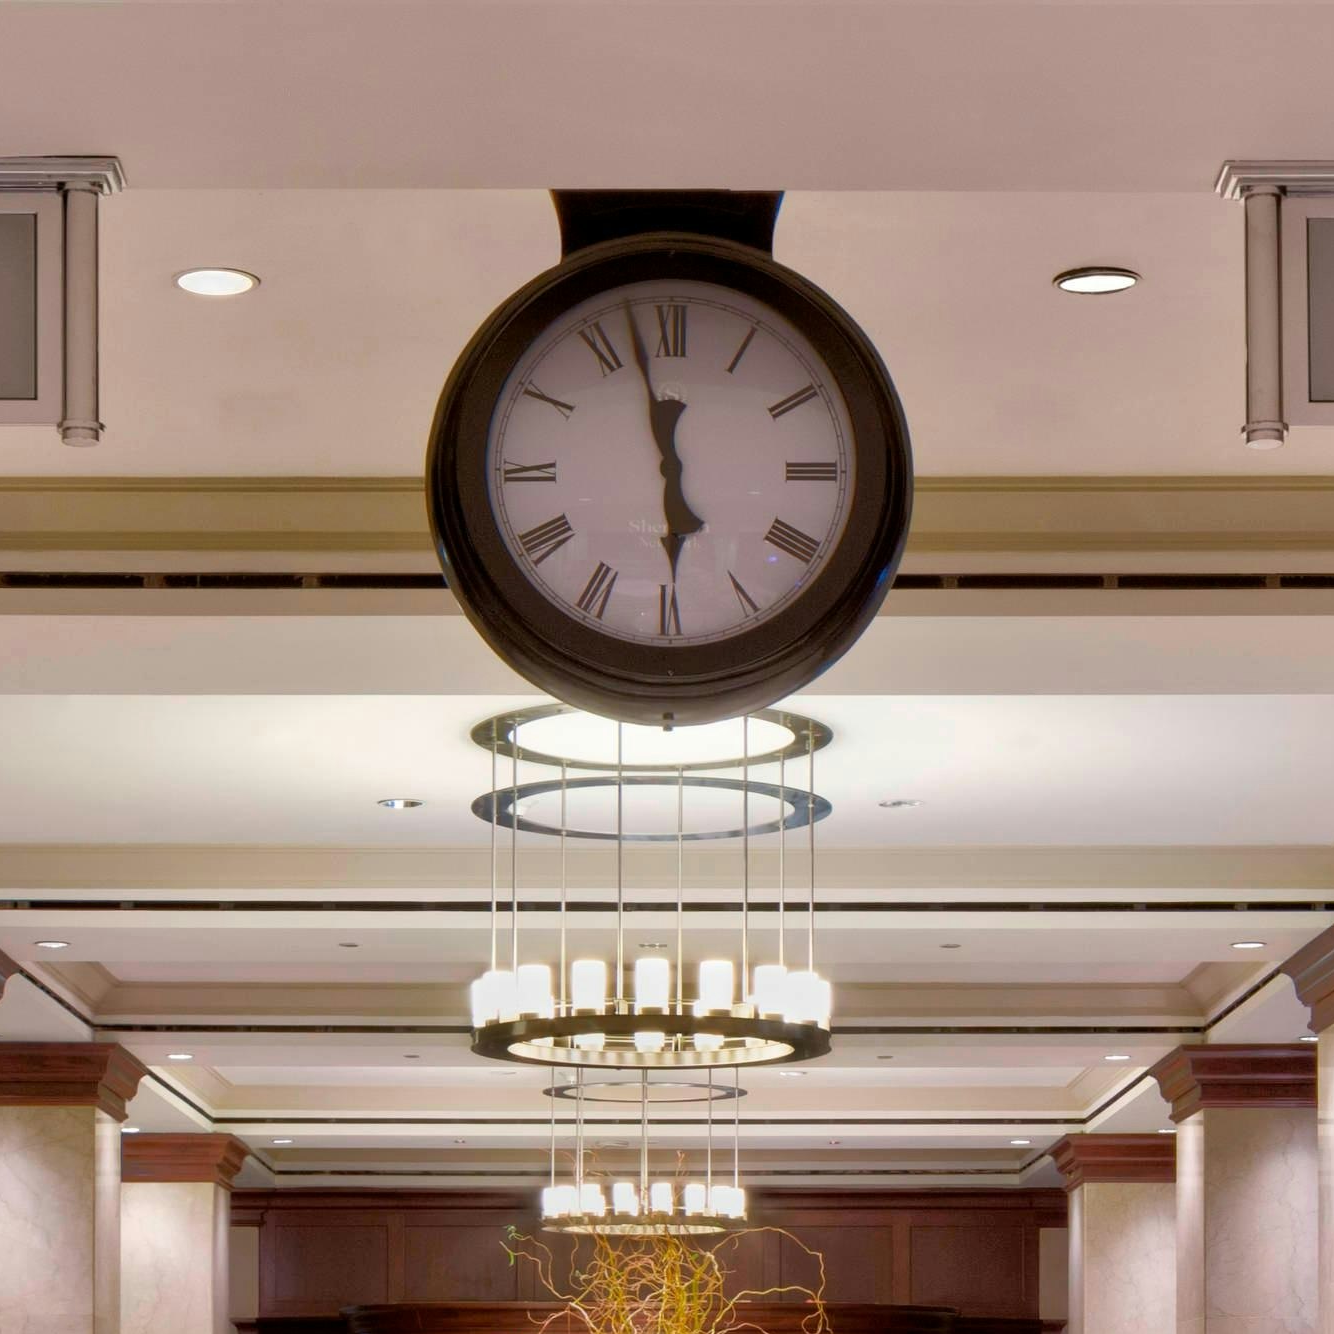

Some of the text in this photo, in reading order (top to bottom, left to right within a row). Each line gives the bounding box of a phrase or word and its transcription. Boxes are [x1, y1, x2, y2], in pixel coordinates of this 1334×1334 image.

[577, 321, 624, 377] XI
[655, 304, 687, 358] XII
[523, 379, 576, 421] X
[767, 383, 819, 419] II
[503, 460, 557, 483] IX
[785, 461, 838, 483] III
[518, 513, 575, 567] VIII
[763, 516, 821, 564] IIII
[575, 561, 619, 620] VII
[659, 583, 682, 636] VI
[727, 569, 761, 619] V
